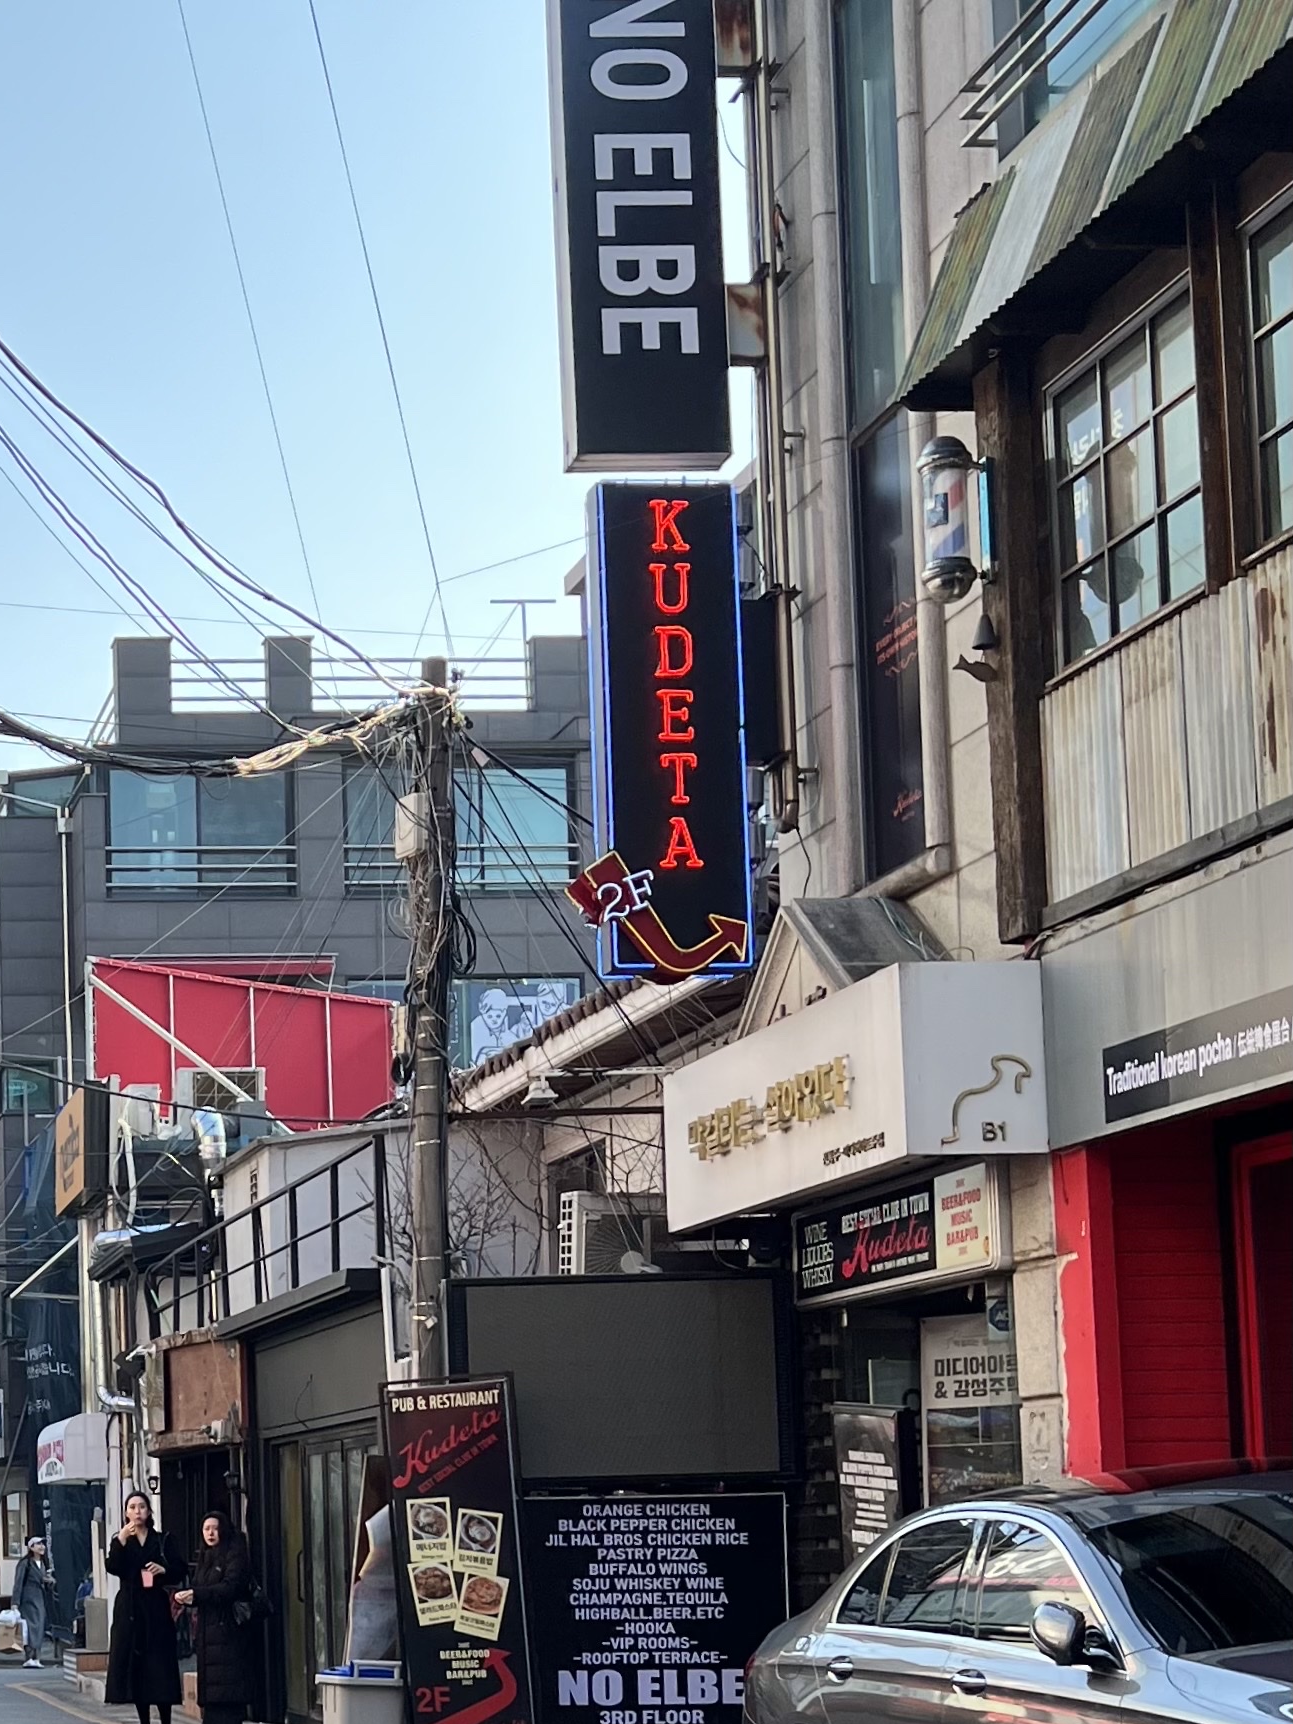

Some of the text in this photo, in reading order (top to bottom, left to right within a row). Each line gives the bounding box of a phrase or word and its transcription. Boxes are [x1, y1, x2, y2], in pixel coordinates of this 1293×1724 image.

[593, 132, 699, 356] ELBE
[649, 499, 704, 868] KUDETA
[597, 868, 655, 922] 2F
[1107, 1051, 1159, 1096] Traditional
[1161, 1048, 1197, 1080] korean
[1198, 1032, 1232, 1077] pocha
[981, 1121, 1007, 1142] B1
[950, 1209, 973, 1227] MUSIC
[804, 1221, 828, 1245] WINE
[842, 1213, 931, 1280] Kudeta
[802, 1263, 834, 1289] WHISKY
[934, 1380, 948, 1399] &
[391, 1389, 500, 1413] PUB & RESTAURANT
[392, 1409, 502, 1489] Kudeta
[583, 1503, 710, 1517] ORANGE CHICKEN
[558, 1518, 735, 1532] BLACK PEPPER CHICKEN
[545, 1532, 749, 1546] JIL HAL BROS CHICKEN RICE
[597, 1548, 699, 1560] PASTRY PIZZA
[589, 1562, 708, 1576] BUFFALO WINGS
[572, 1577, 724, 1591] SOJU WHISKEY WINE
[440, 1649, 490, 1660] BEER&FOOD
[452, 1660, 480, 1669] MUSIC
[446, 1669, 487, 1680] BAR&PUB
[558, 1668, 744, 1707] NO ELBE
[415, 1686, 451, 1713] 2F
[642, 1709, 705, 1724] FLOOR
